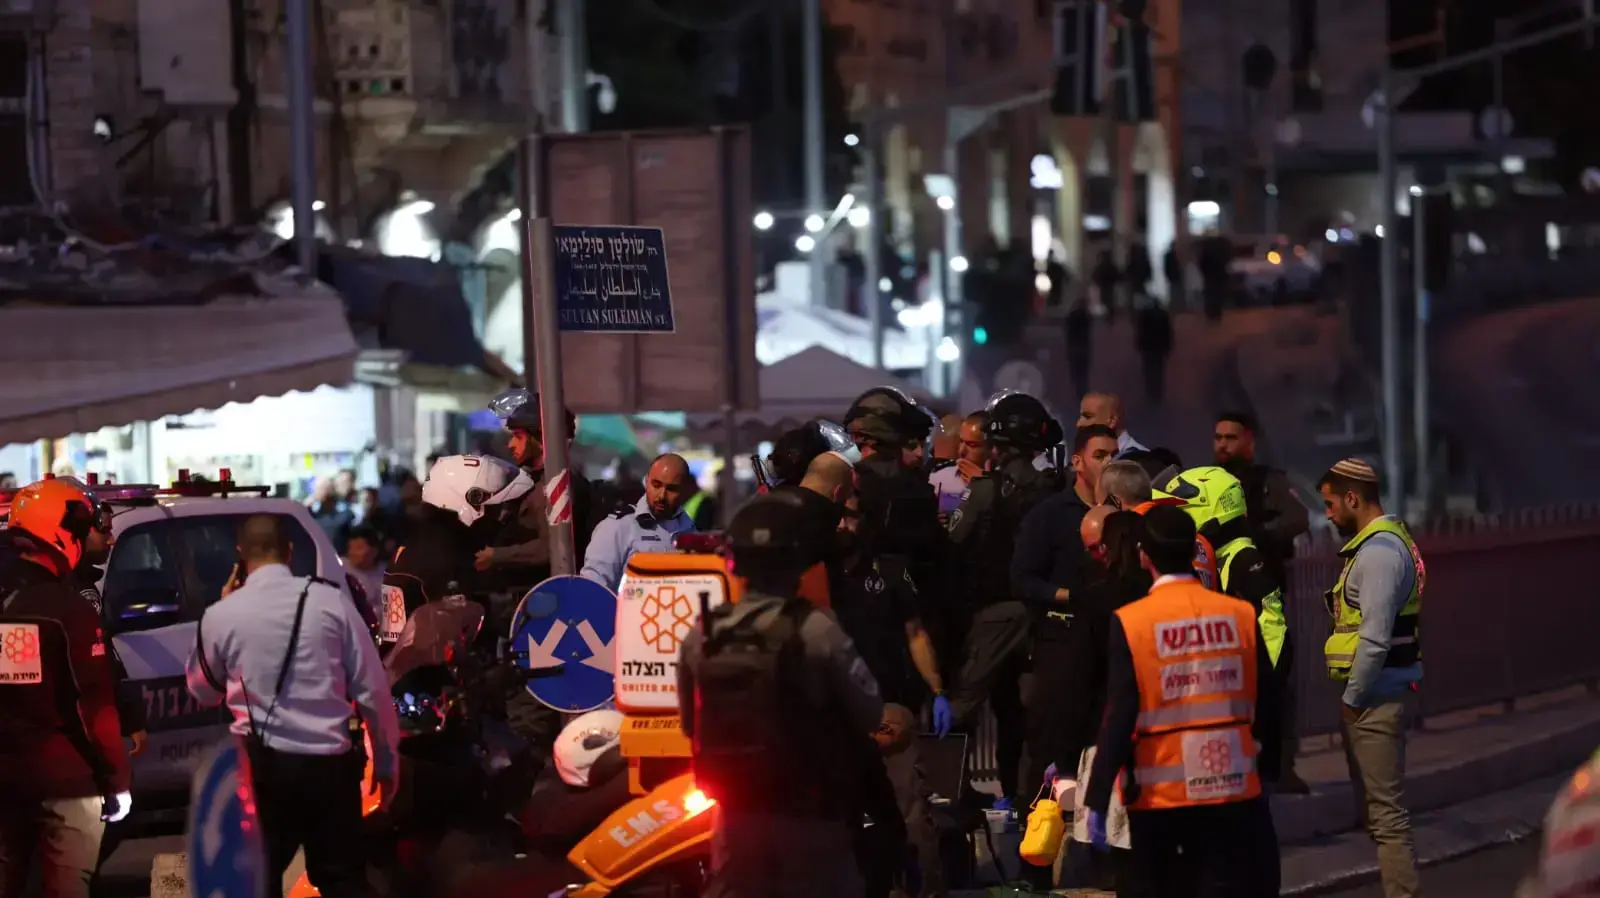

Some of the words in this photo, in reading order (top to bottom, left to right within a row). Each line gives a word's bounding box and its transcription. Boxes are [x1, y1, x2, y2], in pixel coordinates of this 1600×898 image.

[560, 308, 600, 324] SULTAN
[602, 308, 652, 325] SULEIMAN
[1163, 621, 1234, 650] חובש
[622, 660, 665, 677] הצלה
[622, 683, 658, 693] UNITED
